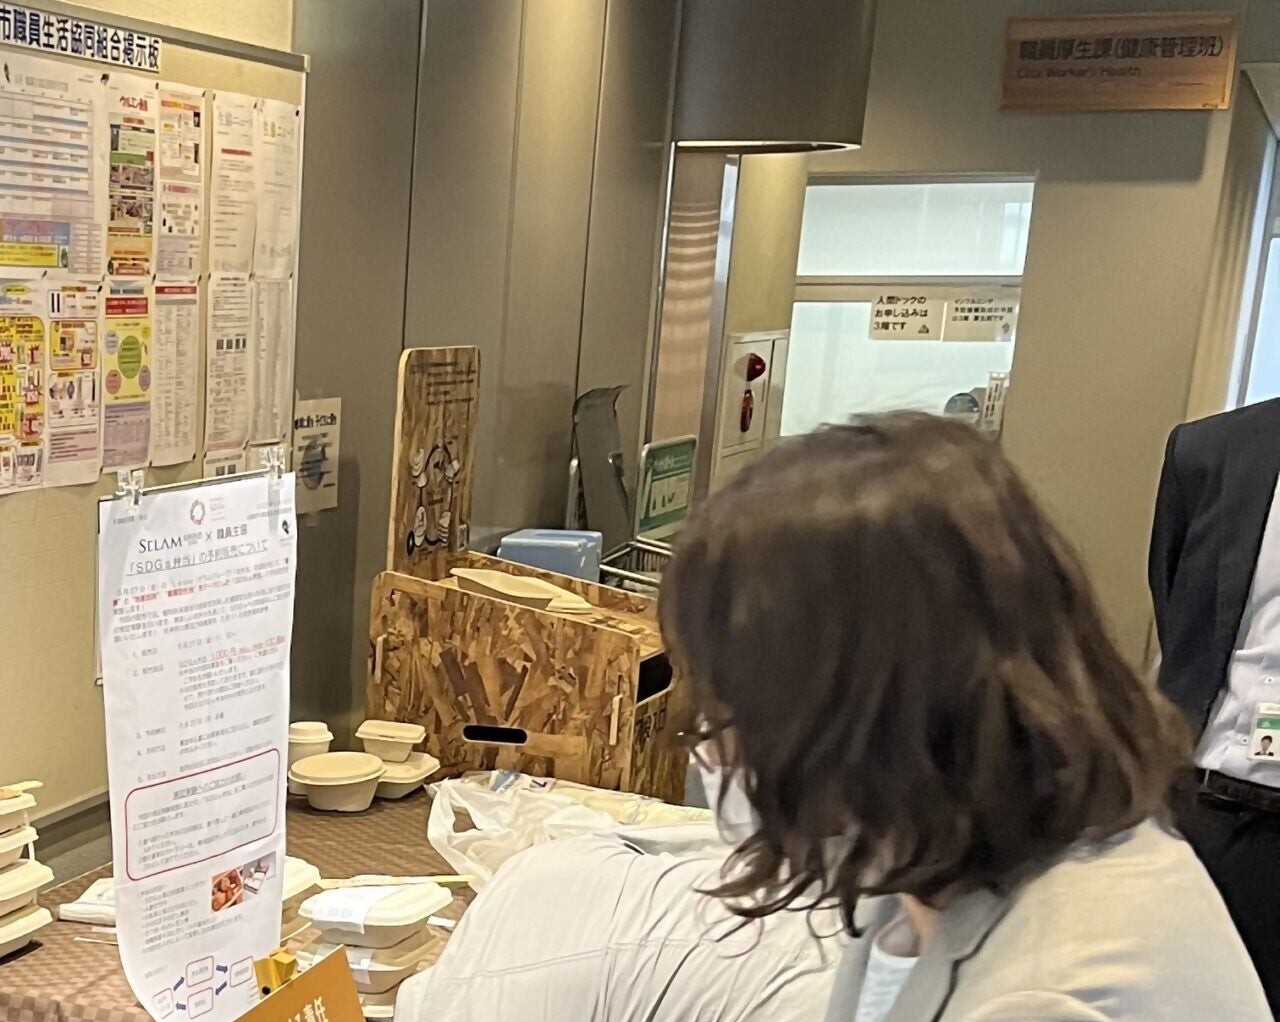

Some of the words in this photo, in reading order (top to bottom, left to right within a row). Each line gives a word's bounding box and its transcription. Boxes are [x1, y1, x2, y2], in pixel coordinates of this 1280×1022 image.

[1017, 67, 1041, 80] City
[1100, 65, 1142, 77] Health
[876, 295, 927, 306] 人間ドックの
[874, 307, 928, 318] お申し込みは
[873, 320, 907, 331] 3階です
